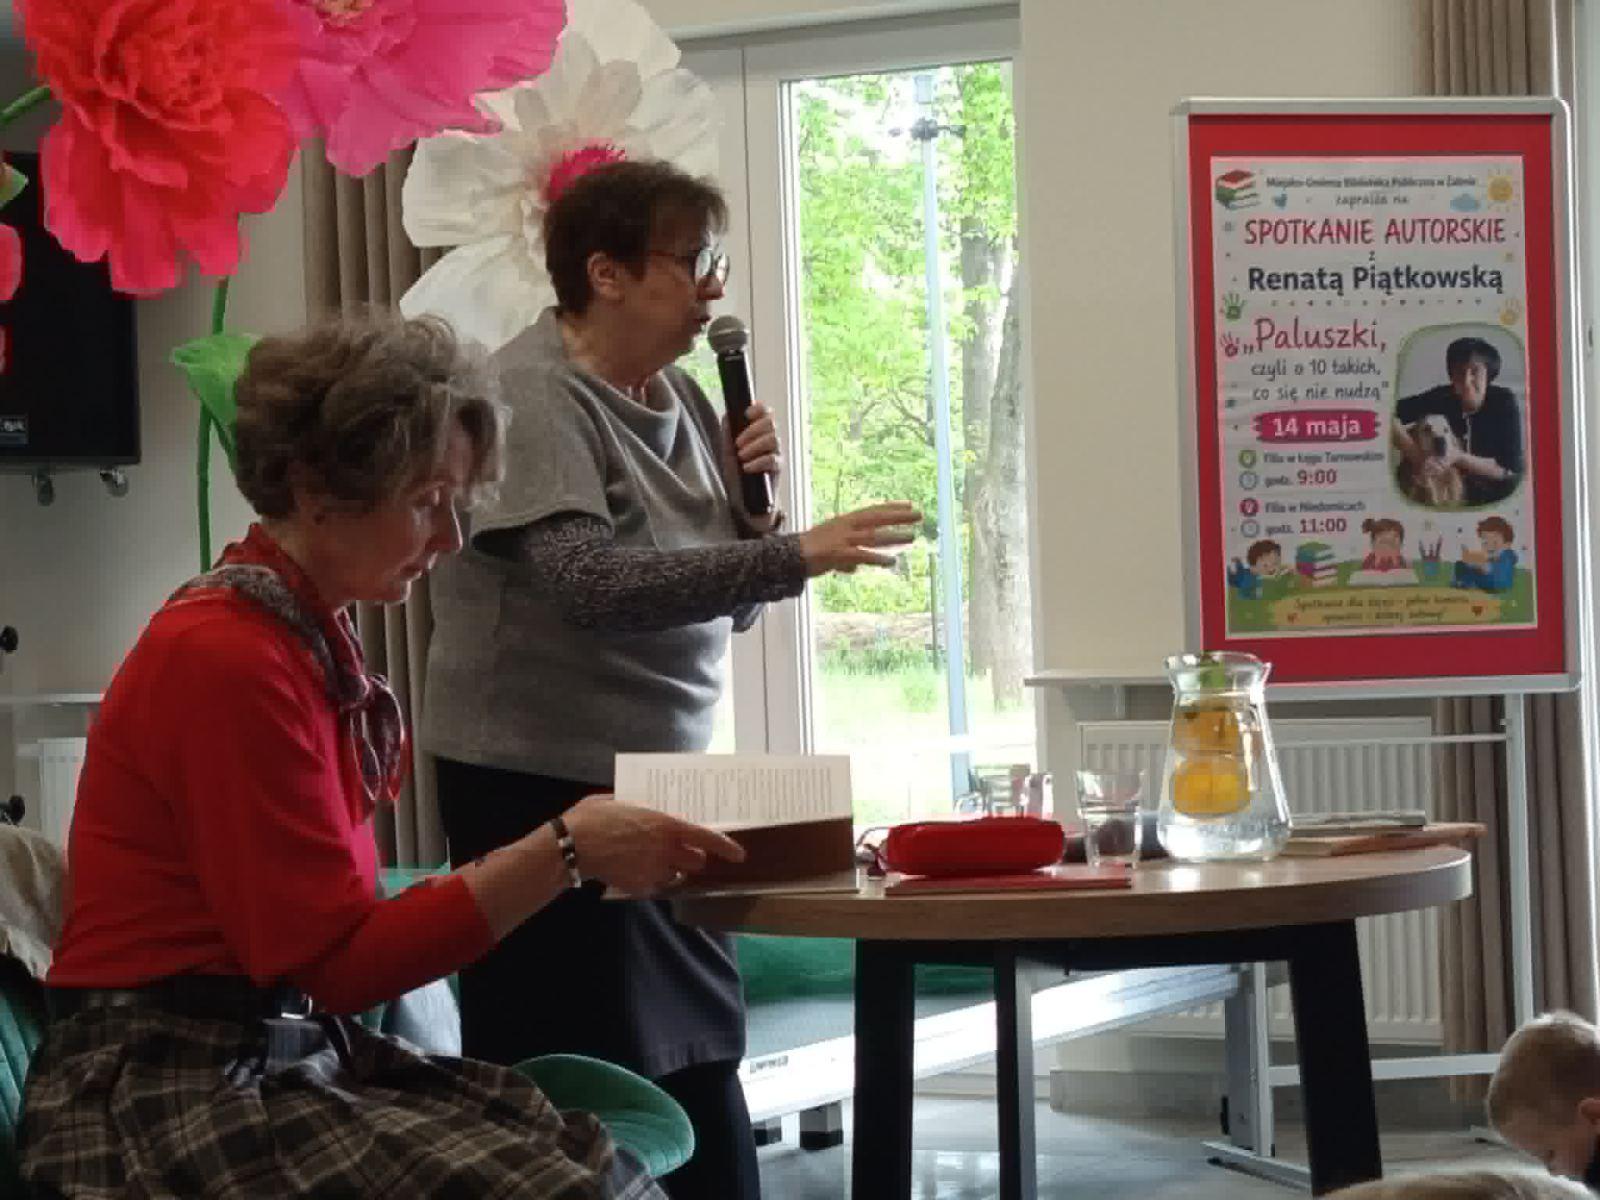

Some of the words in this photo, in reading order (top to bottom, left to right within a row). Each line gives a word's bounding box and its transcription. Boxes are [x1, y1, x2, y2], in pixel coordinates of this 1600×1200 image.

[1244, 217, 1375, 245] SPOTKANIE
[1385, 217, 1506, 245] AUTORSKIE
[1248, 266, 1344, 296] Renatą
[1353, 263, 1503, 296] Piątkowską
[1251, 359, 1287, 382] czyli
[1294, 363, 1305, 376] o
[1310, 359, 1326, 376] 10
[1252, 387, 1270, 401] co
[1278, 383, 1298, 404] się
[1305, 382, 1328, 400] nie
[1272, 416, 1299, 437] 14
[1305, 412, 1361, 440] maja
[1297, 467, 1337, 486] 9:00
[1300, 517, 1347, 534] 11:00
